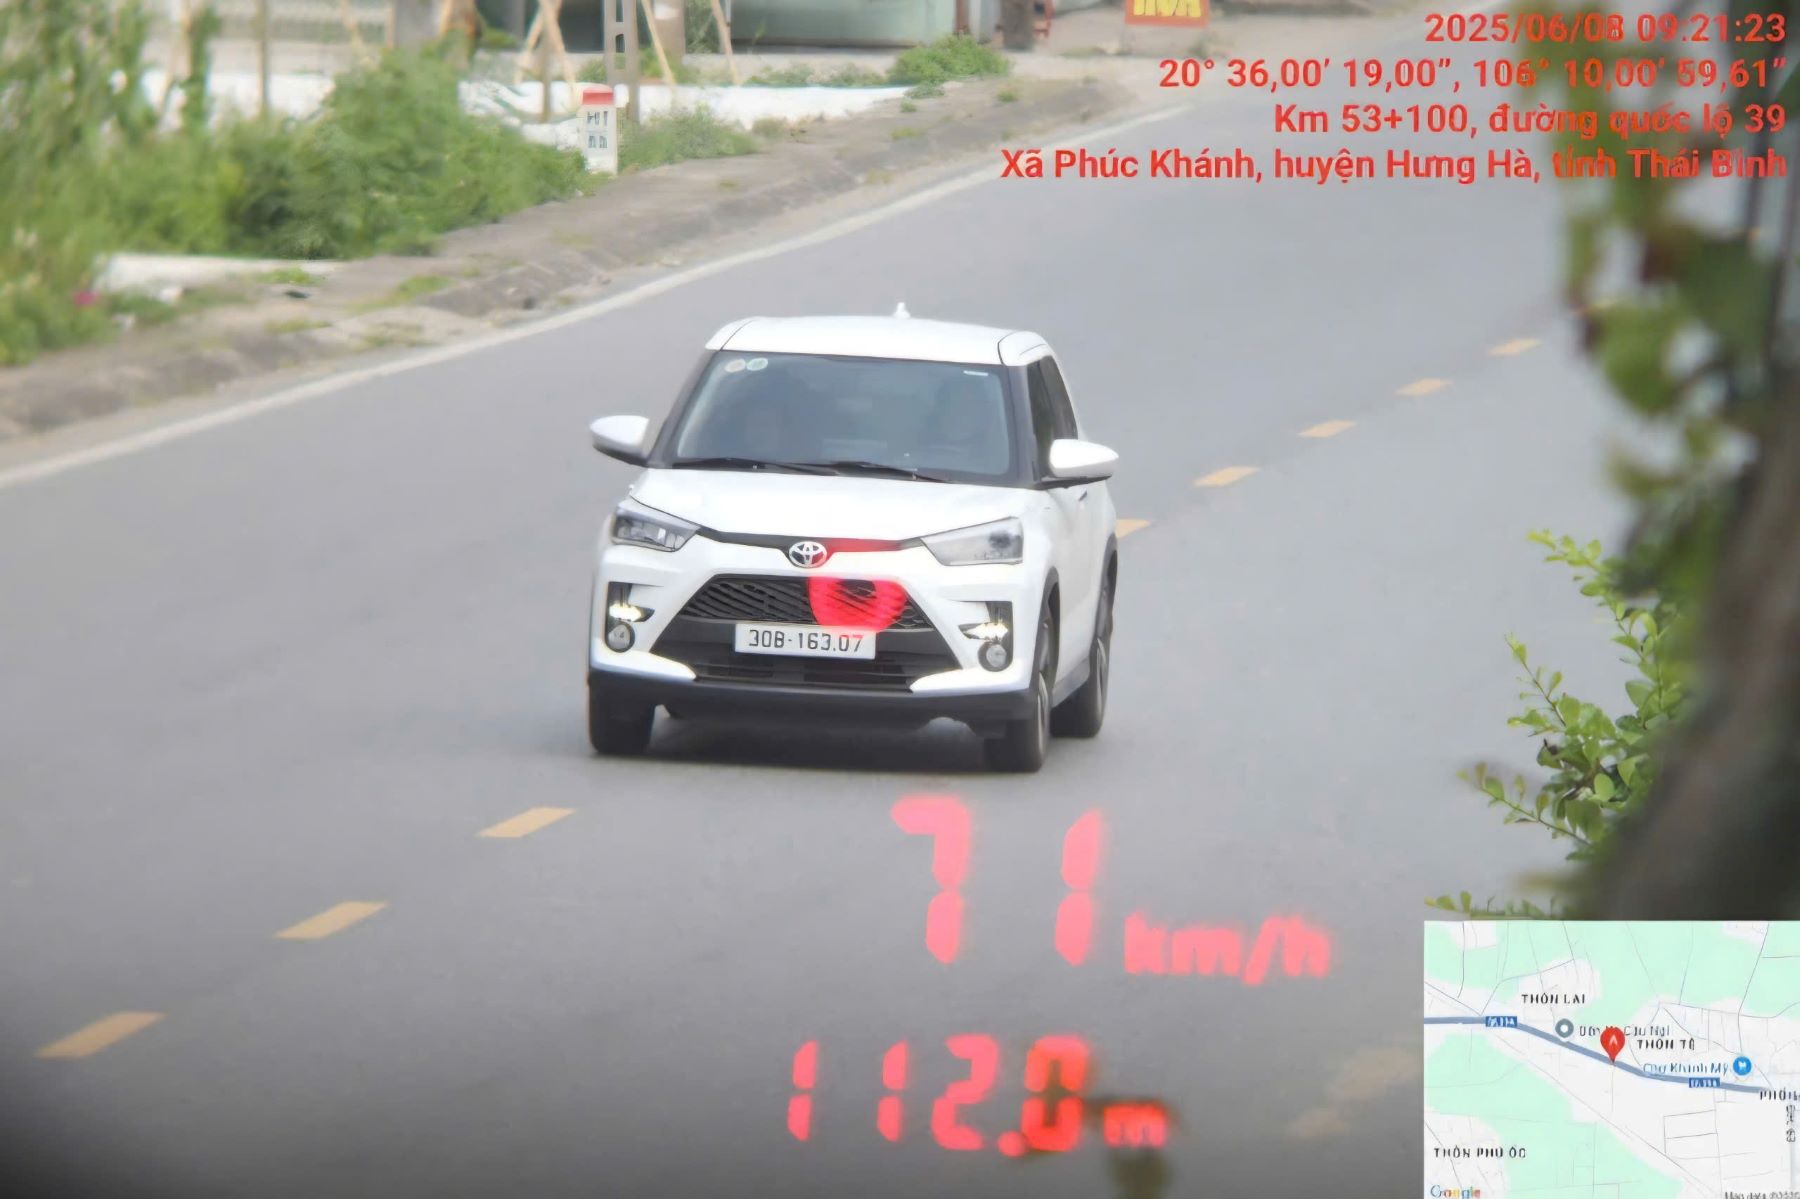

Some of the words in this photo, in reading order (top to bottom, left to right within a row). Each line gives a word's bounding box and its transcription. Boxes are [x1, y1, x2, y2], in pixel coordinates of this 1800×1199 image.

[749, 629, 864, 653] 30B-163.07
[892, 796, 1103, 965] 71
[1123, 911, 1331, 985] km/h
[1102, 1102, 1170, 1148] m
